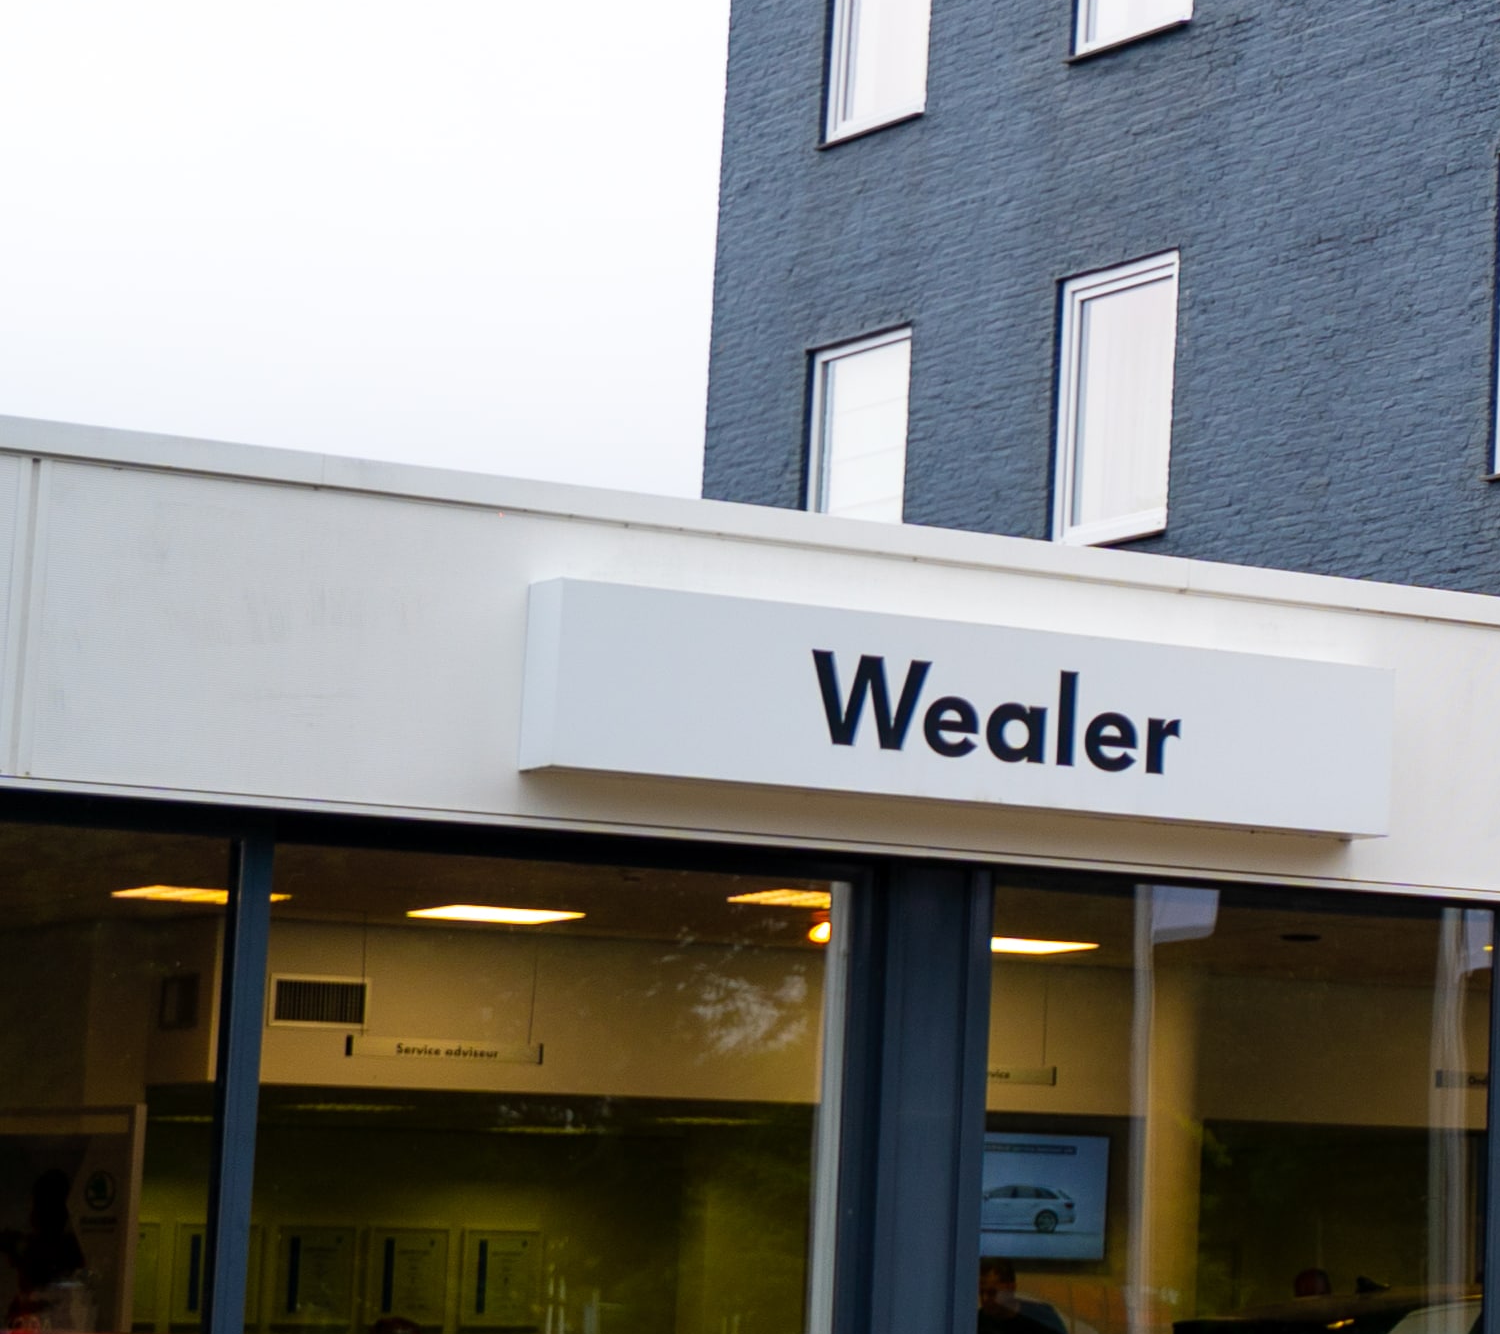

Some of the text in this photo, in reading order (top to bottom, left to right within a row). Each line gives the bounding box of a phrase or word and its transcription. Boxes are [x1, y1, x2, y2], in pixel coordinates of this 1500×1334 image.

[812, 649, 1181, 775] Wealer
[396, 1042, 499, 1058] Service adviseur
